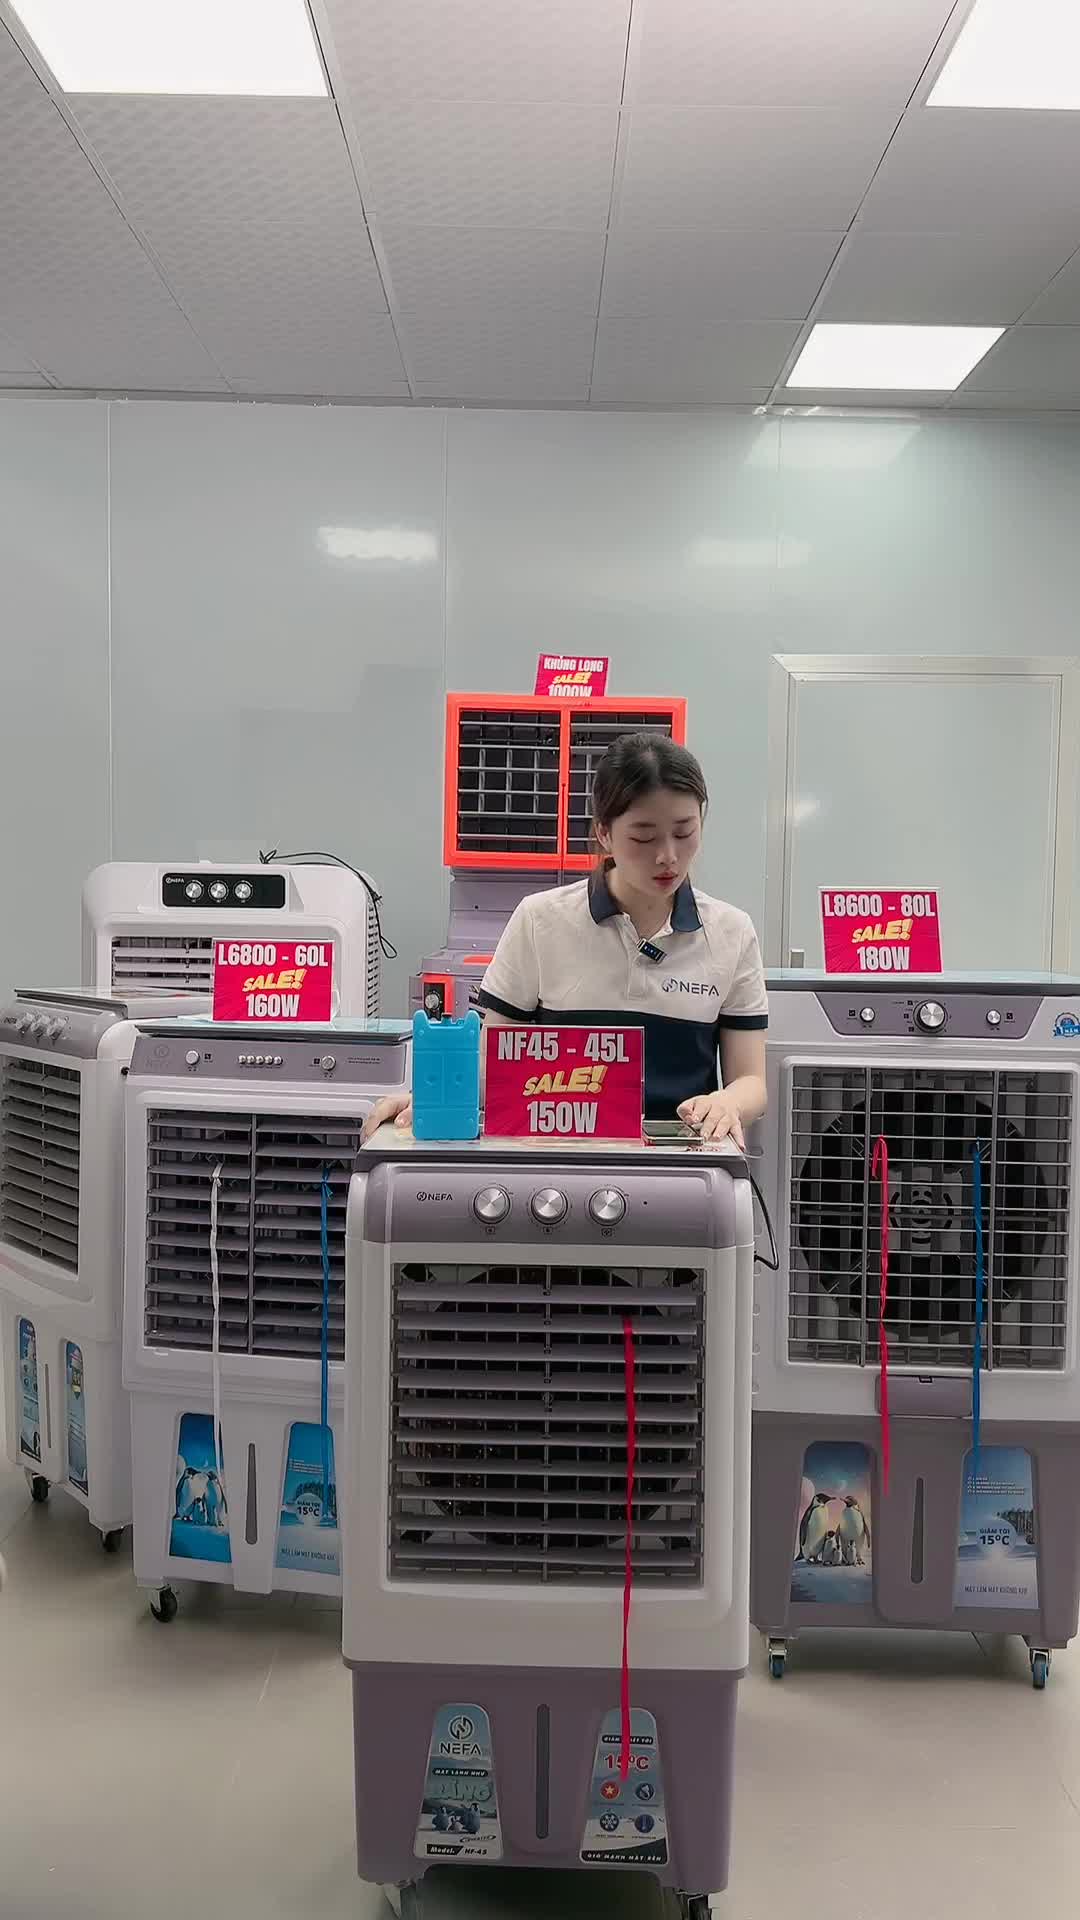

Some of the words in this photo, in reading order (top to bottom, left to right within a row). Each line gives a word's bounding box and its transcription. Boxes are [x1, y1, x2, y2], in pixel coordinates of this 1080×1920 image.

[553, 671, 592, 684] SALE!
[578, 660, 603, 672] LONG
[548, 684, 592, 697] 1000W
[823, 894, 882, 917] L8600
[901, 894, 935, 917] 80L
[852, 918, 913, 943] SALE!
[218, 943, 276, 966] L6800
[295, 945, 328, 966] 60L
[857, 946, 910, 970] 180W
[242, 968, 307, 992] SALE!
[680, 981, 719, 997] NEFA
[246, 993, 300, 1017] 160W
[498, 1032, 558, 1061] NF45
[584, 1033, 629, 1062] 45L
[523, 1065, 608, 1096] SALE!
[527, 1101, 598, 1133] 150W
[428, 1193, 453, 1201] NEFA
[440, 1743, 481, 1755] NEFA
